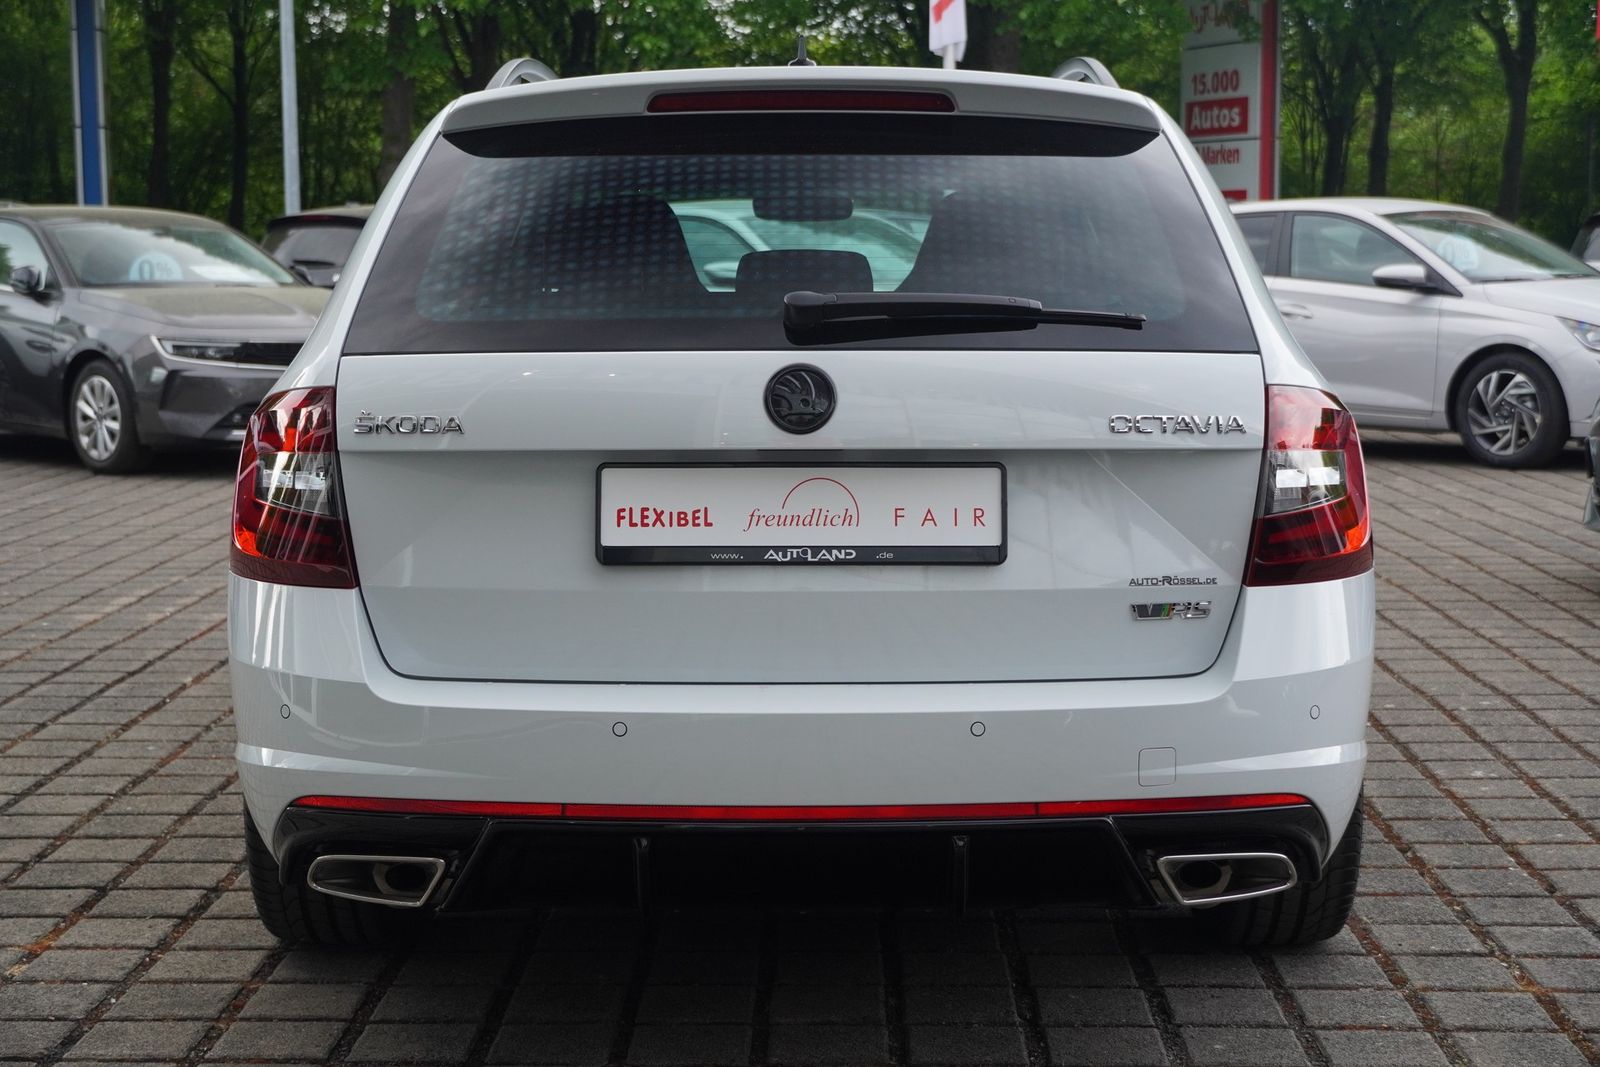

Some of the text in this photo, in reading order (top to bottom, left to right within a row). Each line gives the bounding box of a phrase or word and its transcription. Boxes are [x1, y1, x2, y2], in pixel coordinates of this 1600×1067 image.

[1191, 69, 1240, 97] 15.000
[1190, 106, 1241, 131] Autos
[353, 408, 465, 434] ŠKODA
[1109, 414, 1247, 434] OCTAVIA
[616, 506, 714, 528] FLEXIBEL
[743, 508, 853, 532] freundlich
[710, 547, 894, 562] www. AUTOLAND .de
